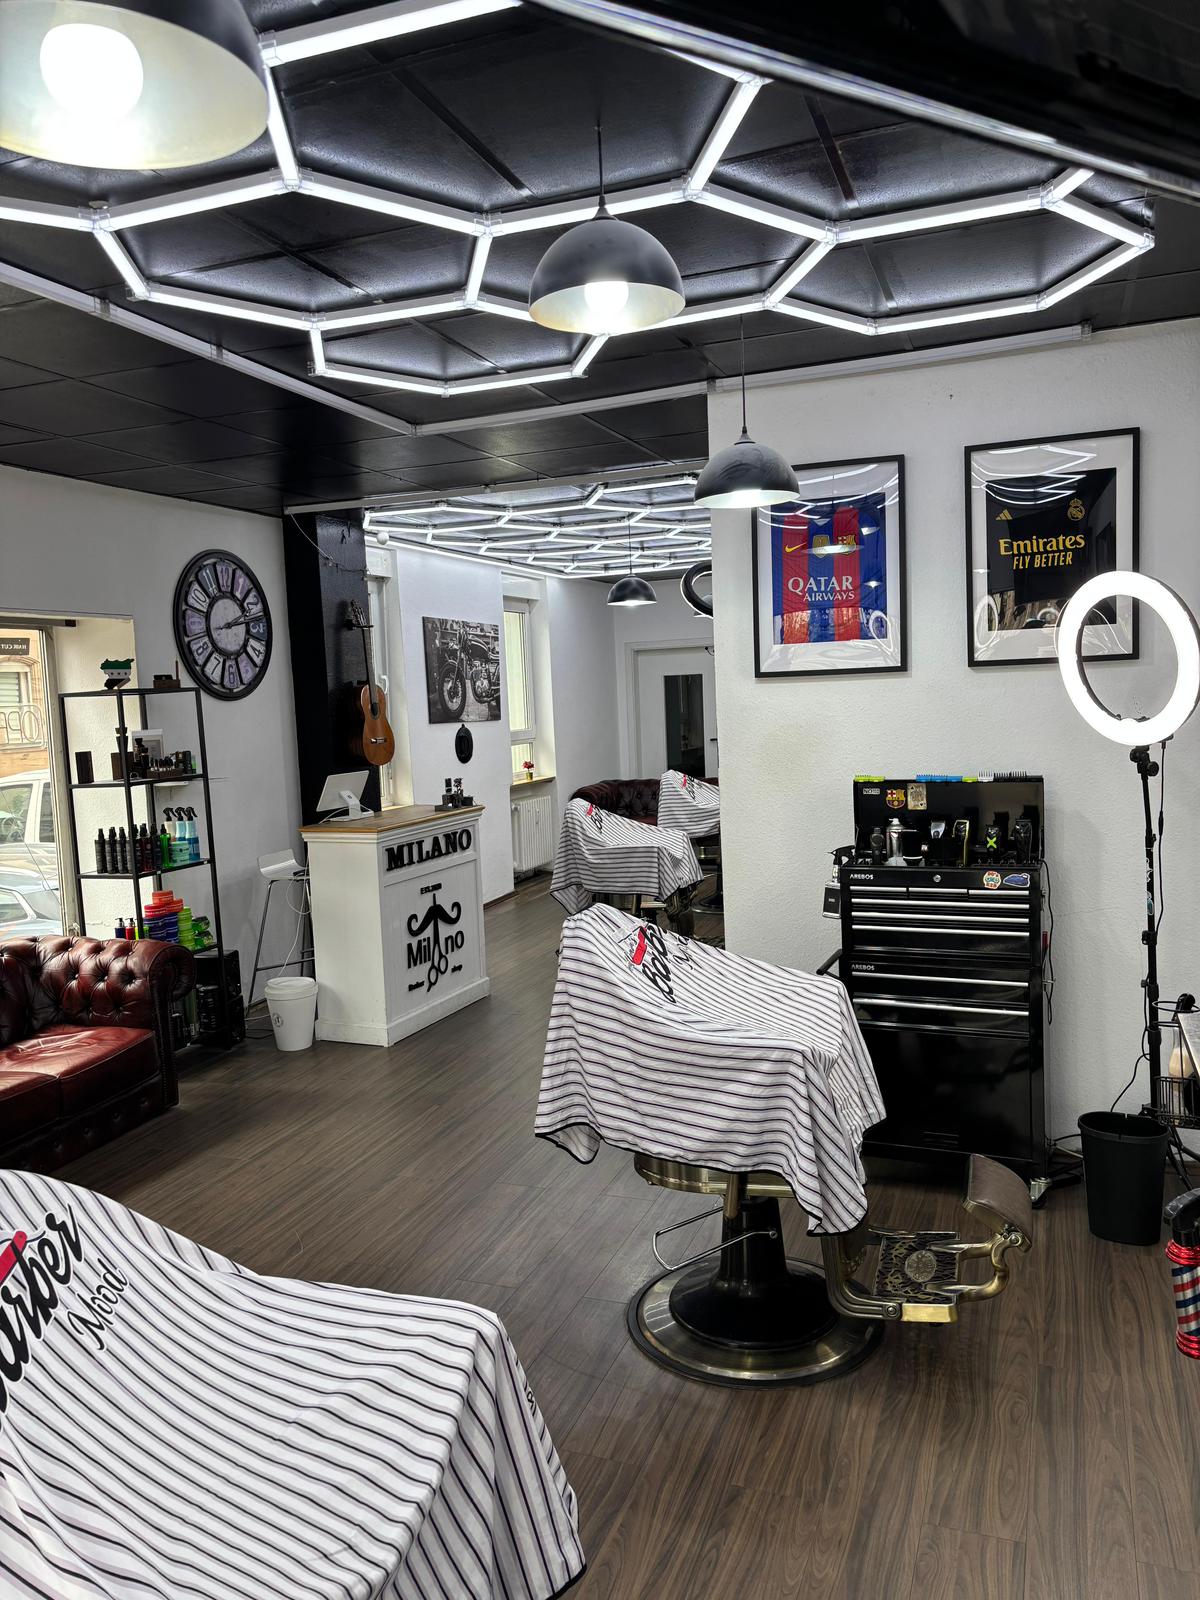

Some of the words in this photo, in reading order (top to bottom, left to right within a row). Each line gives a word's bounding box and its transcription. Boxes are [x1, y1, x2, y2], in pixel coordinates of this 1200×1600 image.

[998, 533, 1086, 556] Emirates
[1013, 555, 1031, 570] FLY
[1034, 551, 1073, 568] BETTER
[219, 567, 230, 589] 12
[787, 575, 854, 596] QATAR
[191, 588, 208, 609] 10
[246, 594, 260, 613] 2
[803, 590, 855, 602] AIRWAYS
[250, 622, 264, 634] 3
[250, 643, 263, 659] 4
[210, 656, 221, 676] 7
[227, 663, 236, 685] 6
[384, 828, 472, 872] MILANO
[67, 1258, 128, 1351] Mood
[0, 1203, 83, 1432] arber
